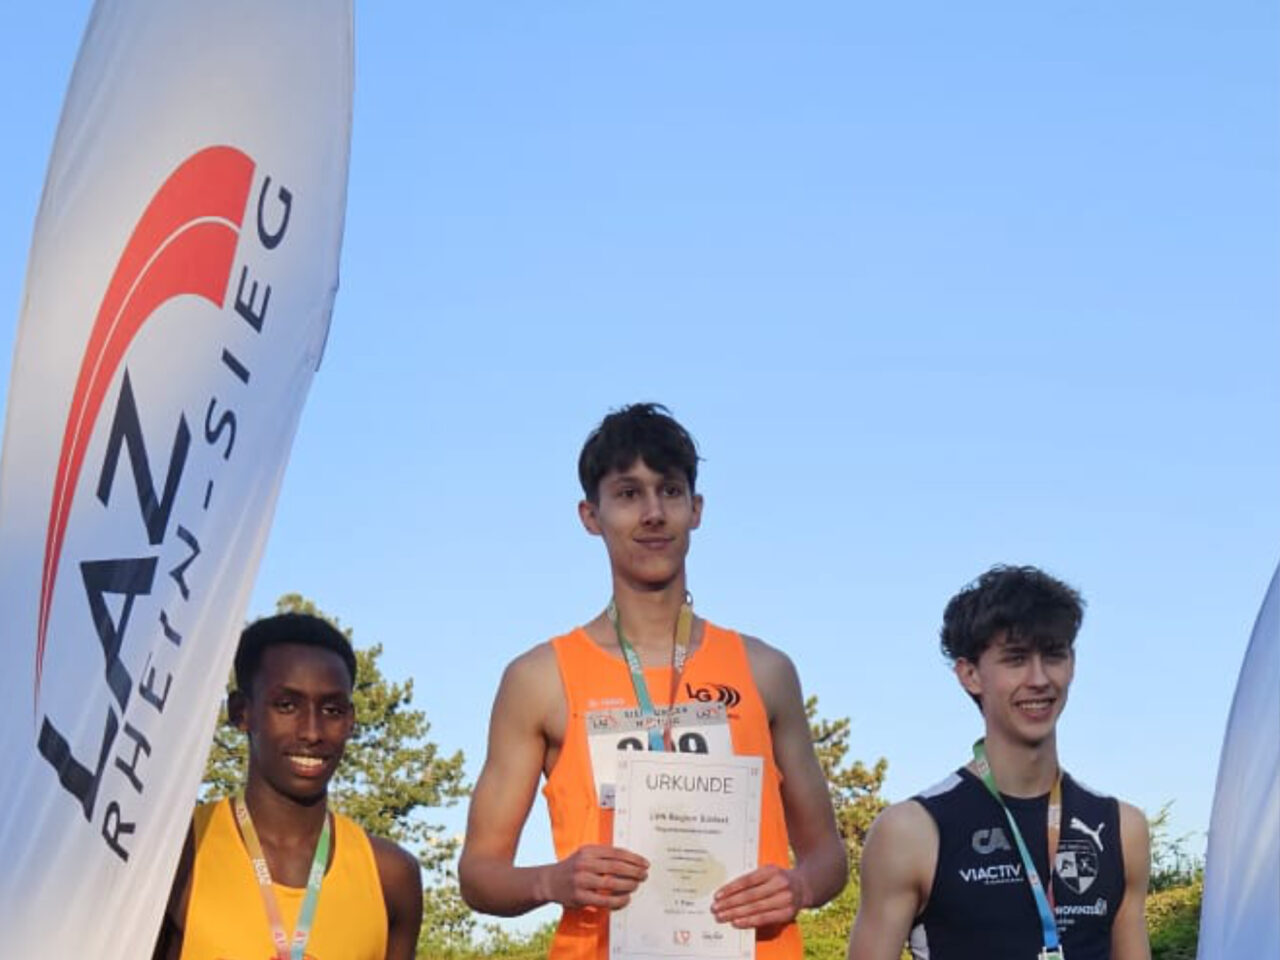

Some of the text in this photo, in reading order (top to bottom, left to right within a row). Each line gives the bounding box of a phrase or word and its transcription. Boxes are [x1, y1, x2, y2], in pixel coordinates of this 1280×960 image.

[37, 364, 192, 824] LAZ
[101, 174, 293, 864] RHEIN-SIEG
[646, 773, 736, 794] URKUNDE
[958, 864, 1022, 882] VIACTIV
